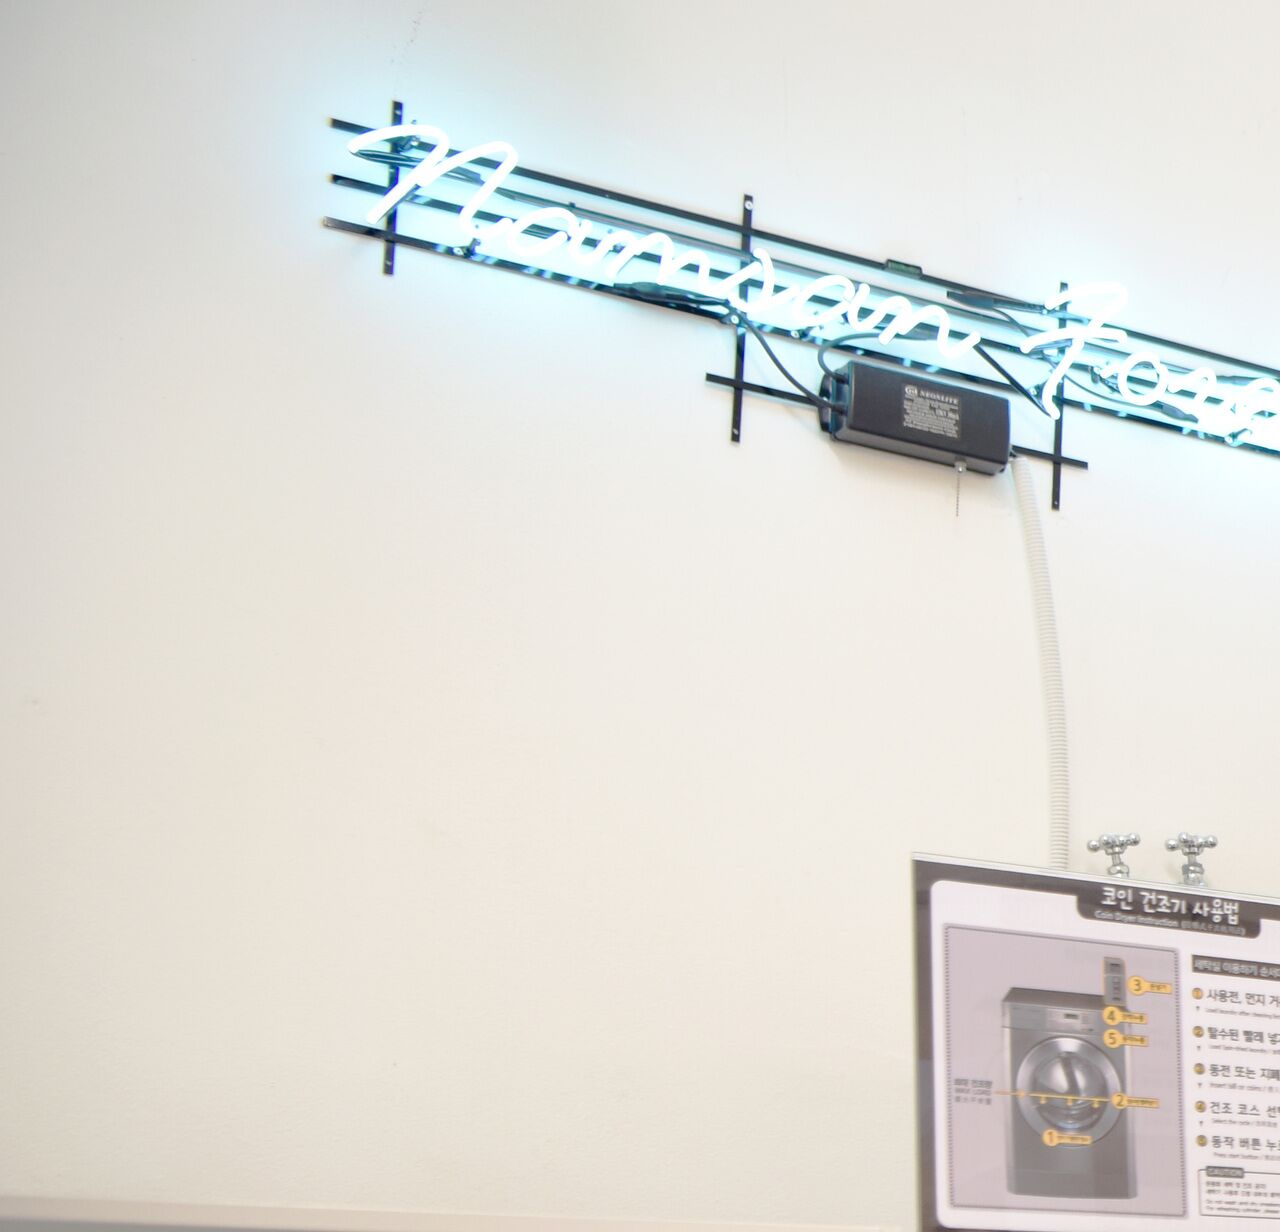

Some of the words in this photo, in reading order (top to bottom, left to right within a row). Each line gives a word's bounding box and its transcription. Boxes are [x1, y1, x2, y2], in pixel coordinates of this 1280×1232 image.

[1101, 886, 1133, 910] 코인
[1139, 892, 1187, 914] 건조기
[1192, 898, 1240, 925] 사용법
[1245, 992, 1265, 1006] 먼지
[1243, 1031, 1264, 1044] 빨래
[1209, 1064, 1231, 1078] 동전
[1234, 1066, 1256, 1080] 또는
[1209, 1102, 1232, 1114] 건조
[1237, 1104, 1260, 1116] 코스
[1212, 1135, 1233, 1148] 동작
[1239, 1137, 1260, 1150] 버튼
